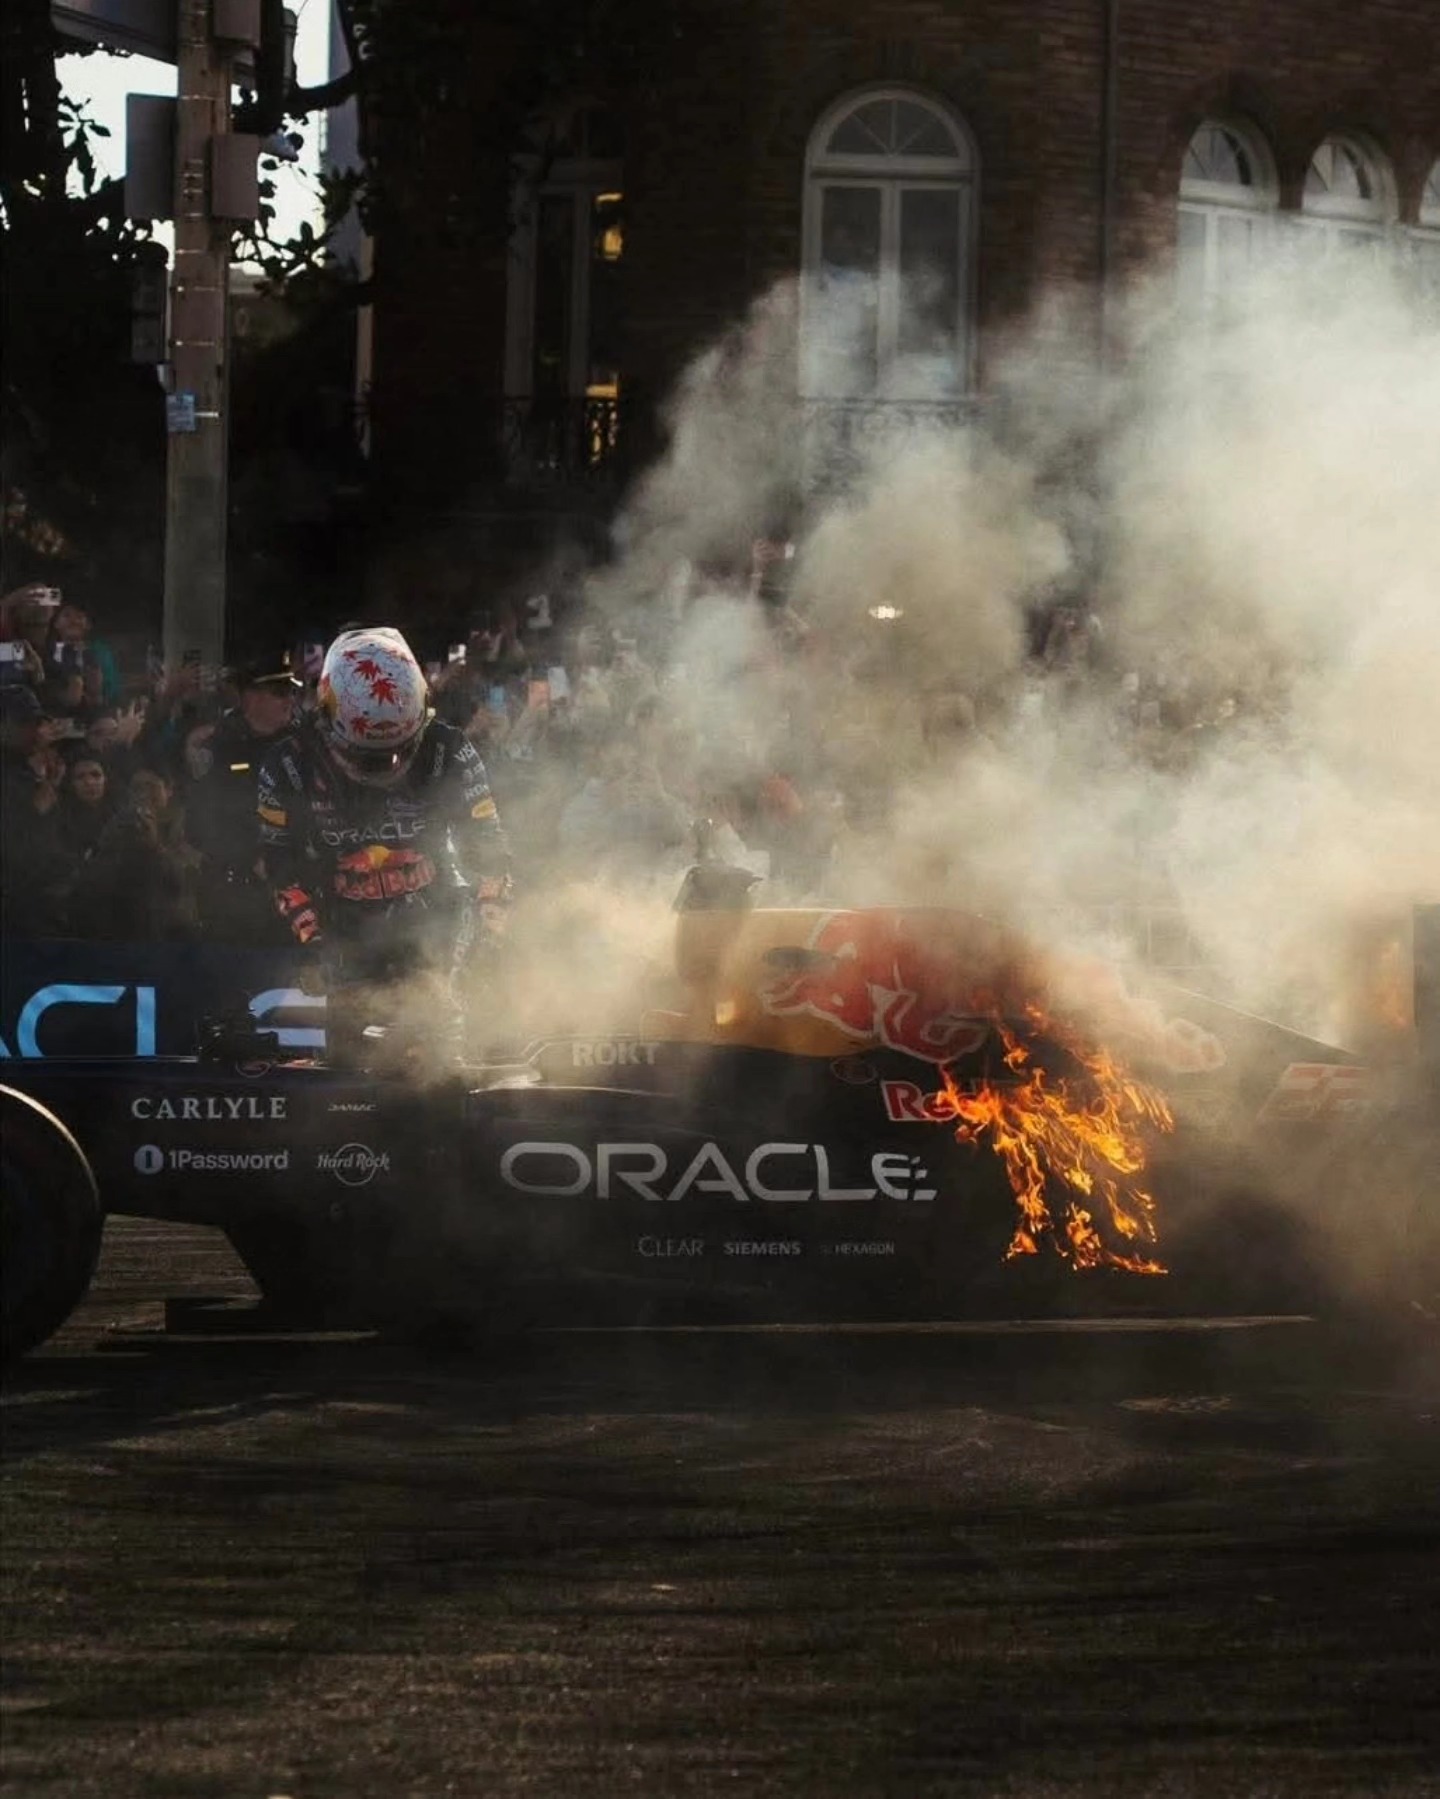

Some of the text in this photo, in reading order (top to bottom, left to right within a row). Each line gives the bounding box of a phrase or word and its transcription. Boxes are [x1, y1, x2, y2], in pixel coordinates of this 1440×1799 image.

[571, 1041, 661, 1067] ROKT
[131, 1097, 288, 1120] CARLYLE
[168, 1149, 288, 1170] 1Password
[316, 1150, 391, 1173] Hard Rock
[501, 1141, 938, 1201] ORACLE
[637, 1235, 705, 1257] CLEAR
[723, 1241, 802, 1256] SIEMENS
[834, 1240, 895, 1256] HEXAGON
